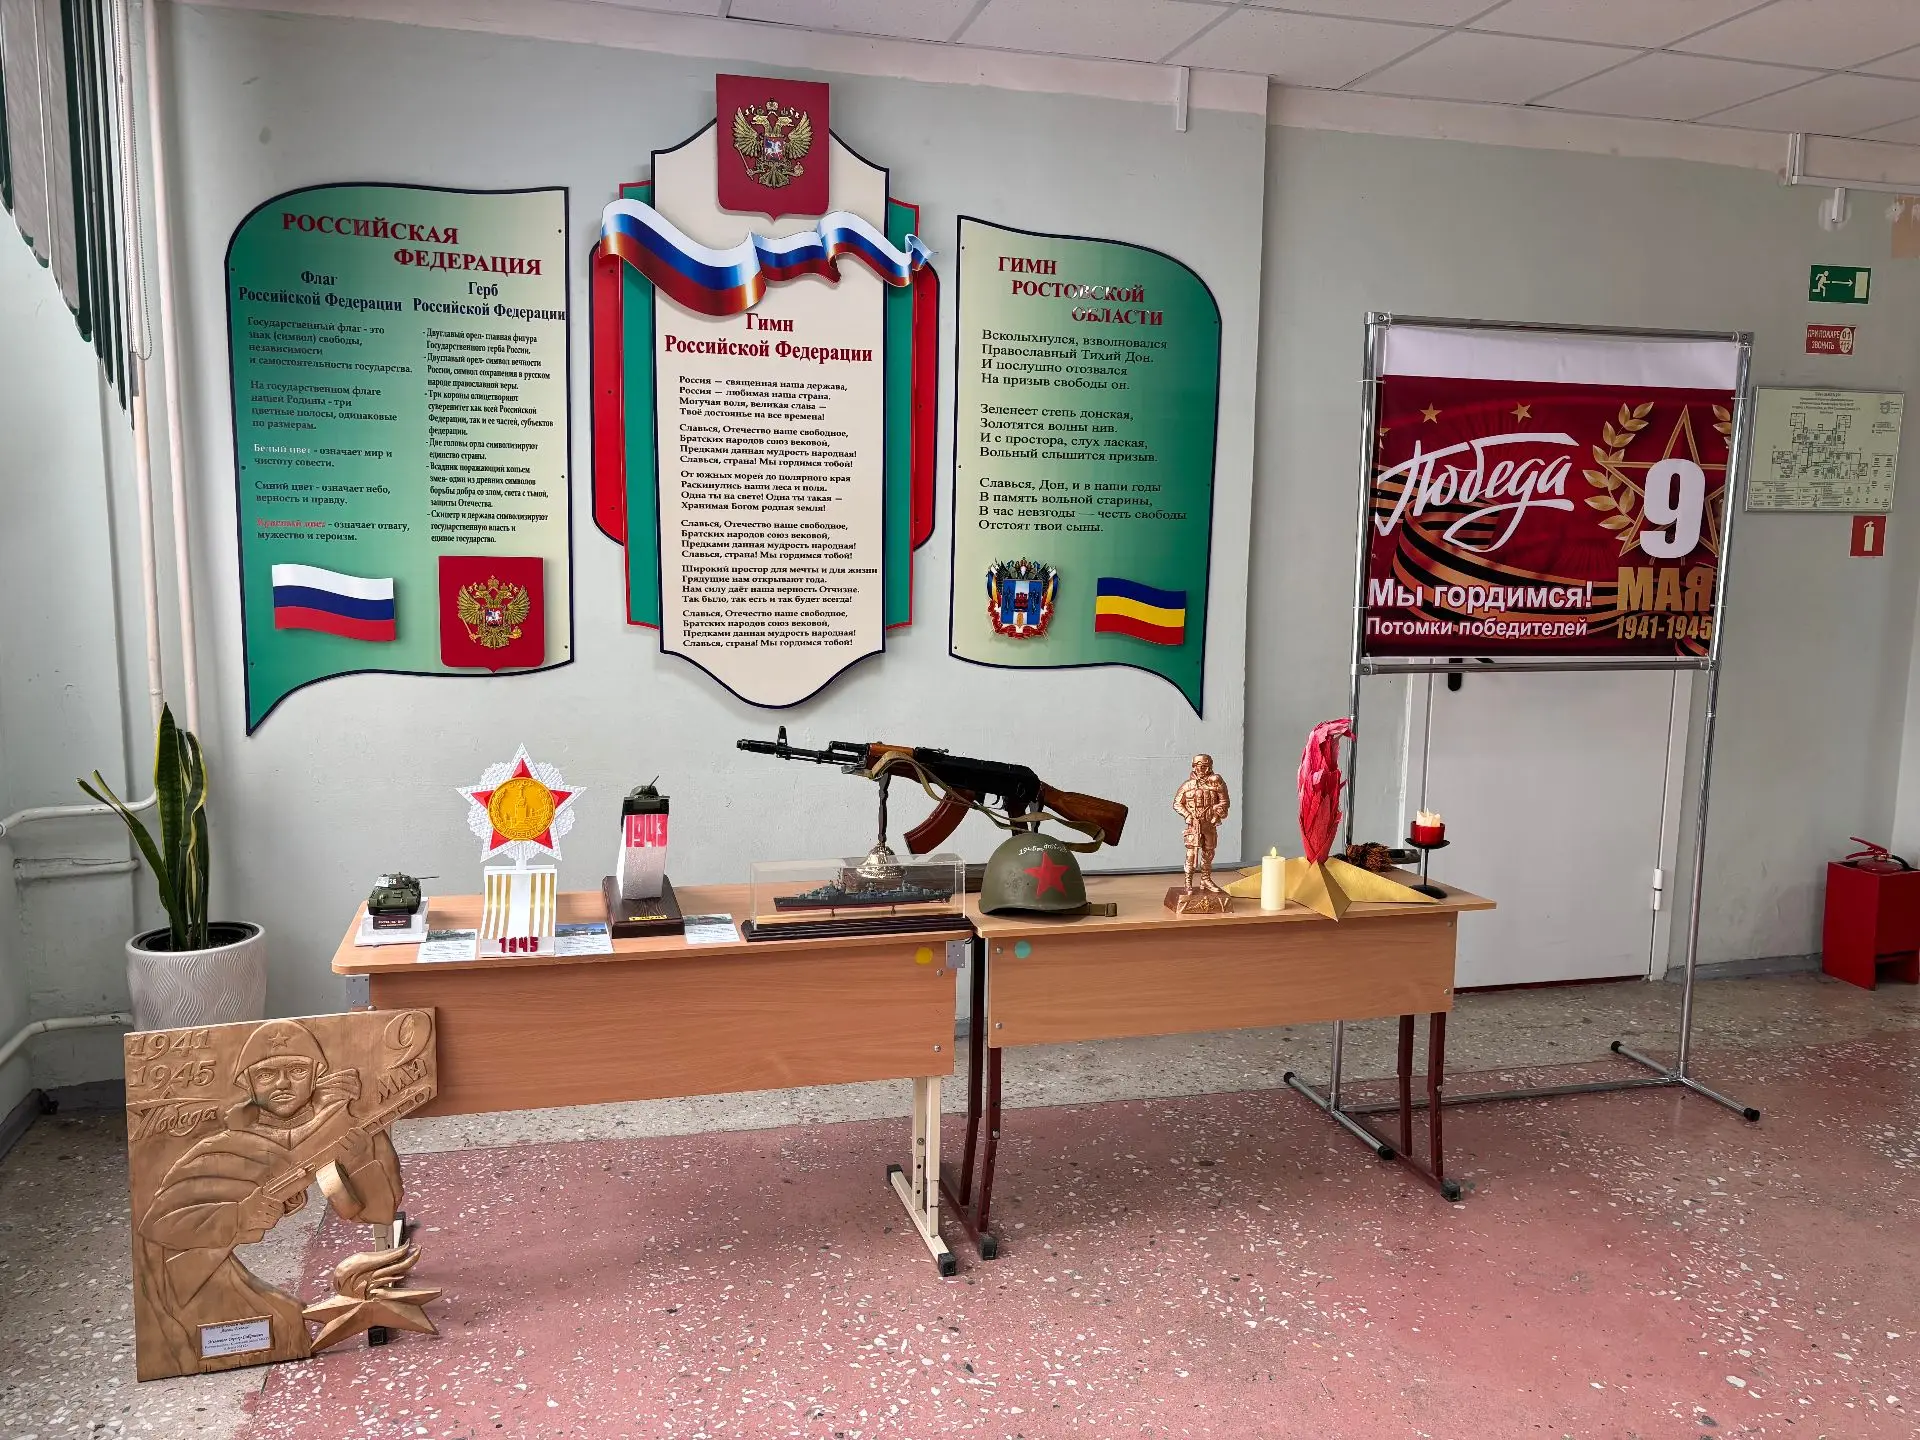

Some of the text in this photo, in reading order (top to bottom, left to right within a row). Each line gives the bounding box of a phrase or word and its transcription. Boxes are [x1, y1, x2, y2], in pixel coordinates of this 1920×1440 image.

[282, 213, 459, 244] РОССИЙСКАЯ
[394, 249, 542, 277] ФЕДЕРАЦИЯ
[998, 256, 1057, 275] ГИМН
[300, 270, 338, 287] Флаг
[239, 286, 402, 313] Российской Федерации
[468, 281, 498, 299] Герб
[1011, 280, 1145, 303] РОСТОВСКОЙ
[413, 298, 566, 322] Российской Федерации
[1071, 306, 1164, 326] ОБЛАСТИ
[745, 313, 794, 332] Гимн
[981, 329, 1166, 348] Всколыхнулся, взволновался
[664, 334, 872, 364] Российской Федерации
[982, 344, 1153, 363] Православный Тихий Дон.
[980, 358, 1127, 375] И послушно отозвался
[981, 372, 1129, 389] На призыв свободы он.
[680, 407, 702, 417] Твоё
[704, 409, 752, 418] достоянье
[783, 413, 824, 421] времена!
[980, 403, 1133, 419] Зеленеет степь донская,
[679, 424, 720, 433] Славься,
[722, 425, 771, 434] Отечество
[799, 428, 848, 437] свободное,
[979, 418, 1044, 430] Золотятся
[1047, 423, 1088, 431] волны
[680, 434, 724, 443] Братских
[725, 437, 764, 445] народов
[790, 439, 830, 447] вековой,
[980, 432, 991, 442] И
[1005, 435, 1067, 447] простора,
[1070, 438, 1100, 448] слух
[1103, 439, 1147, 448] лаская,
[679, 455, 721, 464] Славься,
[723, 458, 756, 466] страна!
[759, 457, 776, 465] Мы
[680, 444, 728, 454] Предками
[766, 449, 809, 457] мудрость
[811, 450, 856, 458] народная!
[979, 447, 1157, 463] Вольный слышится призыв.
[681, 480, 742, 490] Раскинулись
[734, 473, 763, 481] морей
[778, 474, 827, 482] полярного
[979, 478, 1035, 490] Славься,
[1038, 479, 1068, 491] Дон,
[1072, 482, 1080, 490] и
[1131, 484, 1160, 492] годы
[979, 491, 1152, 507] В память вольной старины,
[1375, 432, 1579, 552] Победа
[978, 505, 988, 515] В
[992, 508, 1013, 516] час
[1017, 509, 1076, 517] невзгоды
[1134, 509, 1187, 519] свободы
[1640, 458, 1705, 558] 9
[978, 519, 1030, 530] Отстоят
[682, 564, 729, 574] Широкий
[1369, 578, 1593, 613] Мы гордимся!
[1616, 566, 1714, 611] МАЯ
[1366, 618, 1587, 637] Потомки победителей
[1617, 615, 1713, 640] 1941-1945
[498, 936, 538, 953] 1945
[129, 1029, 211, 1061] 1941
[383, 1011, 432, 1070] 9
[128, 1059, 216, 1091] 1945
[377, 1057, 429, 1103] МАЯ
[127, 1094, 220, 1142] Победа
